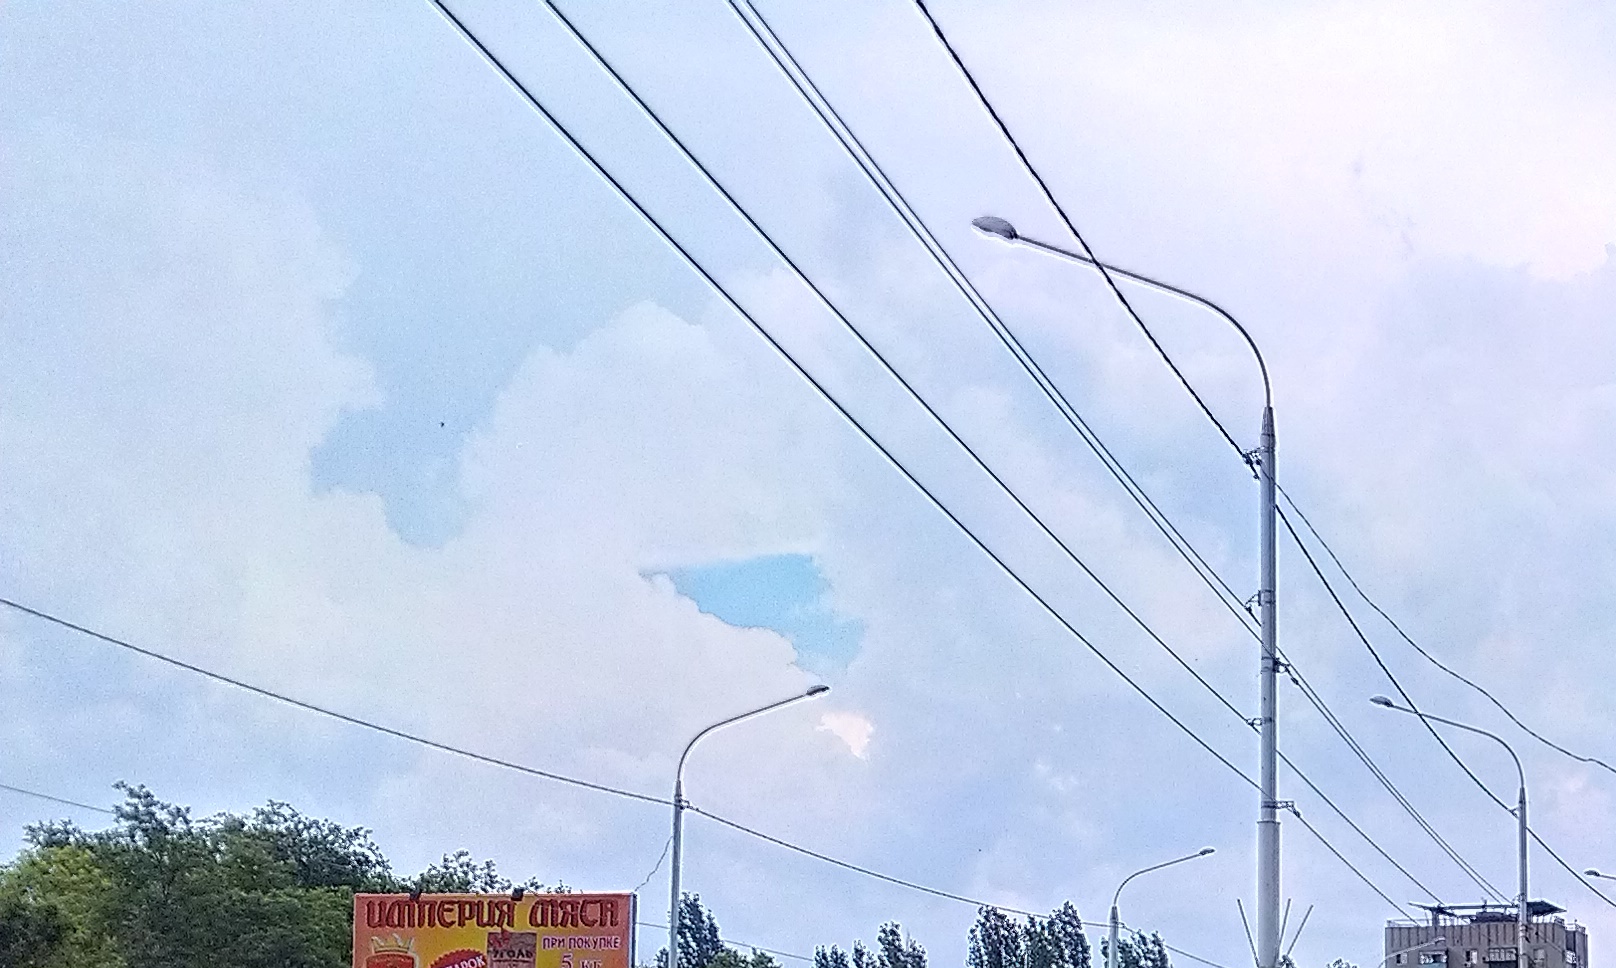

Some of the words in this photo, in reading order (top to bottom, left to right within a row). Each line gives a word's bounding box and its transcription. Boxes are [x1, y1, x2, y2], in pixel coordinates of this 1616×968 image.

[366, 899, 516, 929] ИМПЕРИЯ
[529, 898, 619, 928] МЯСА
[542, 936, 566, 950] ПРИ
[568, 936, 620, 950] ПОКУПКЕ
[493, 948, 534, 959] УГОЛЬ
